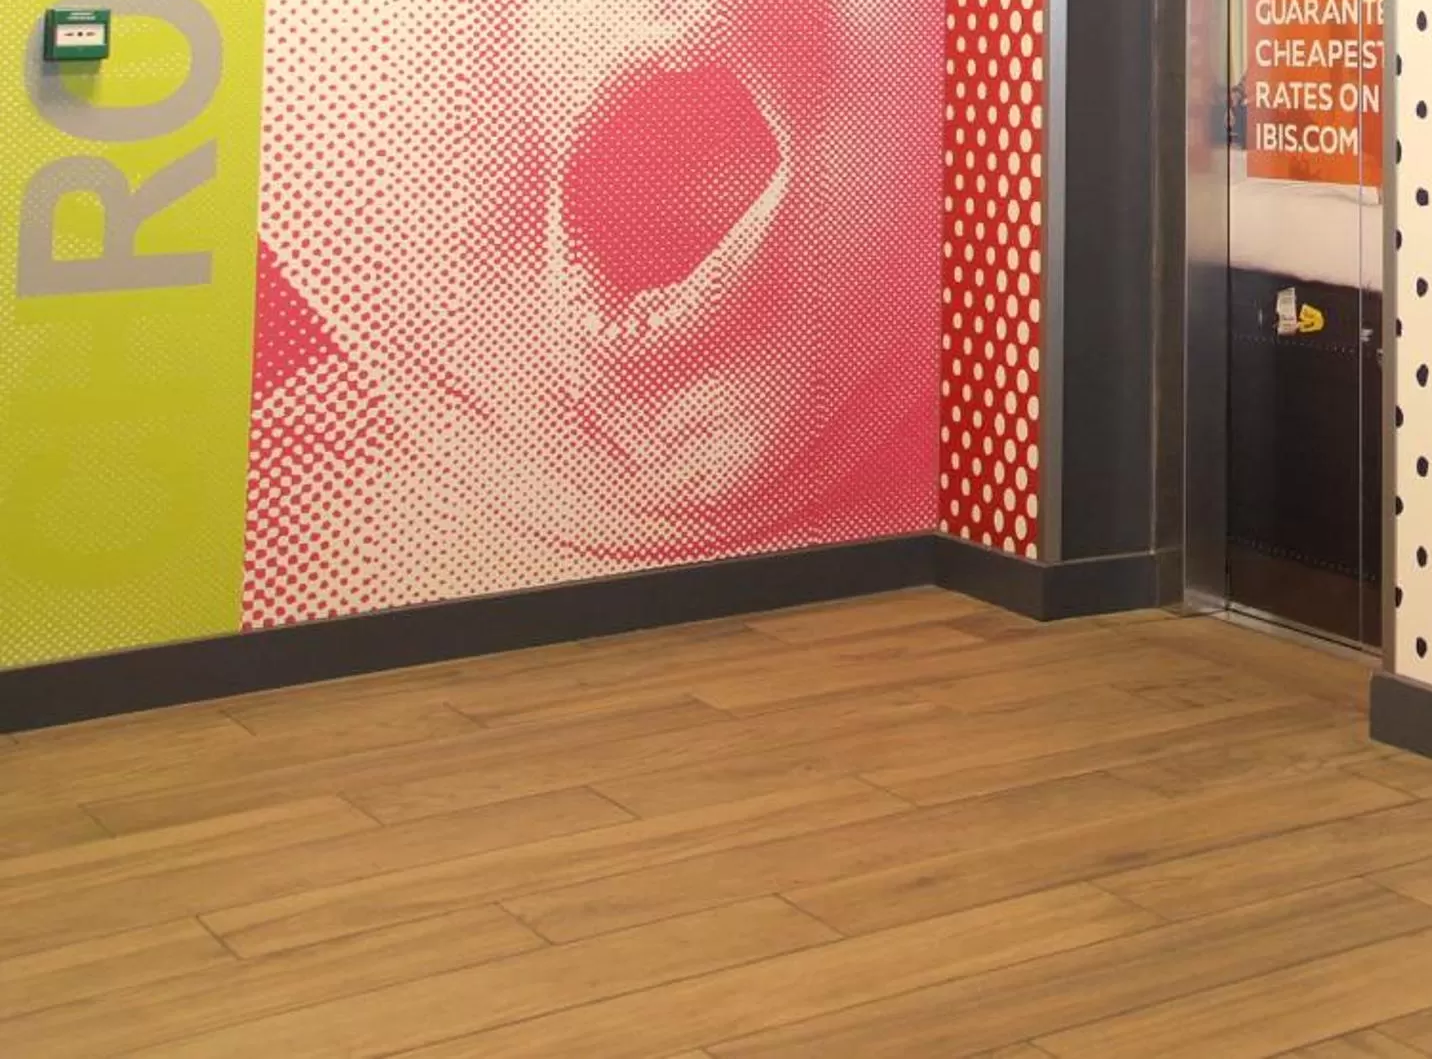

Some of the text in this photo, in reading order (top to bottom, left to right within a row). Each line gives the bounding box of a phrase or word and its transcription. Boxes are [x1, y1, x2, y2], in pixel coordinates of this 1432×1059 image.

[1255, 81, 1380, 113] RATES ON
[1256, 123, 1358, 156] IBIS.COM
